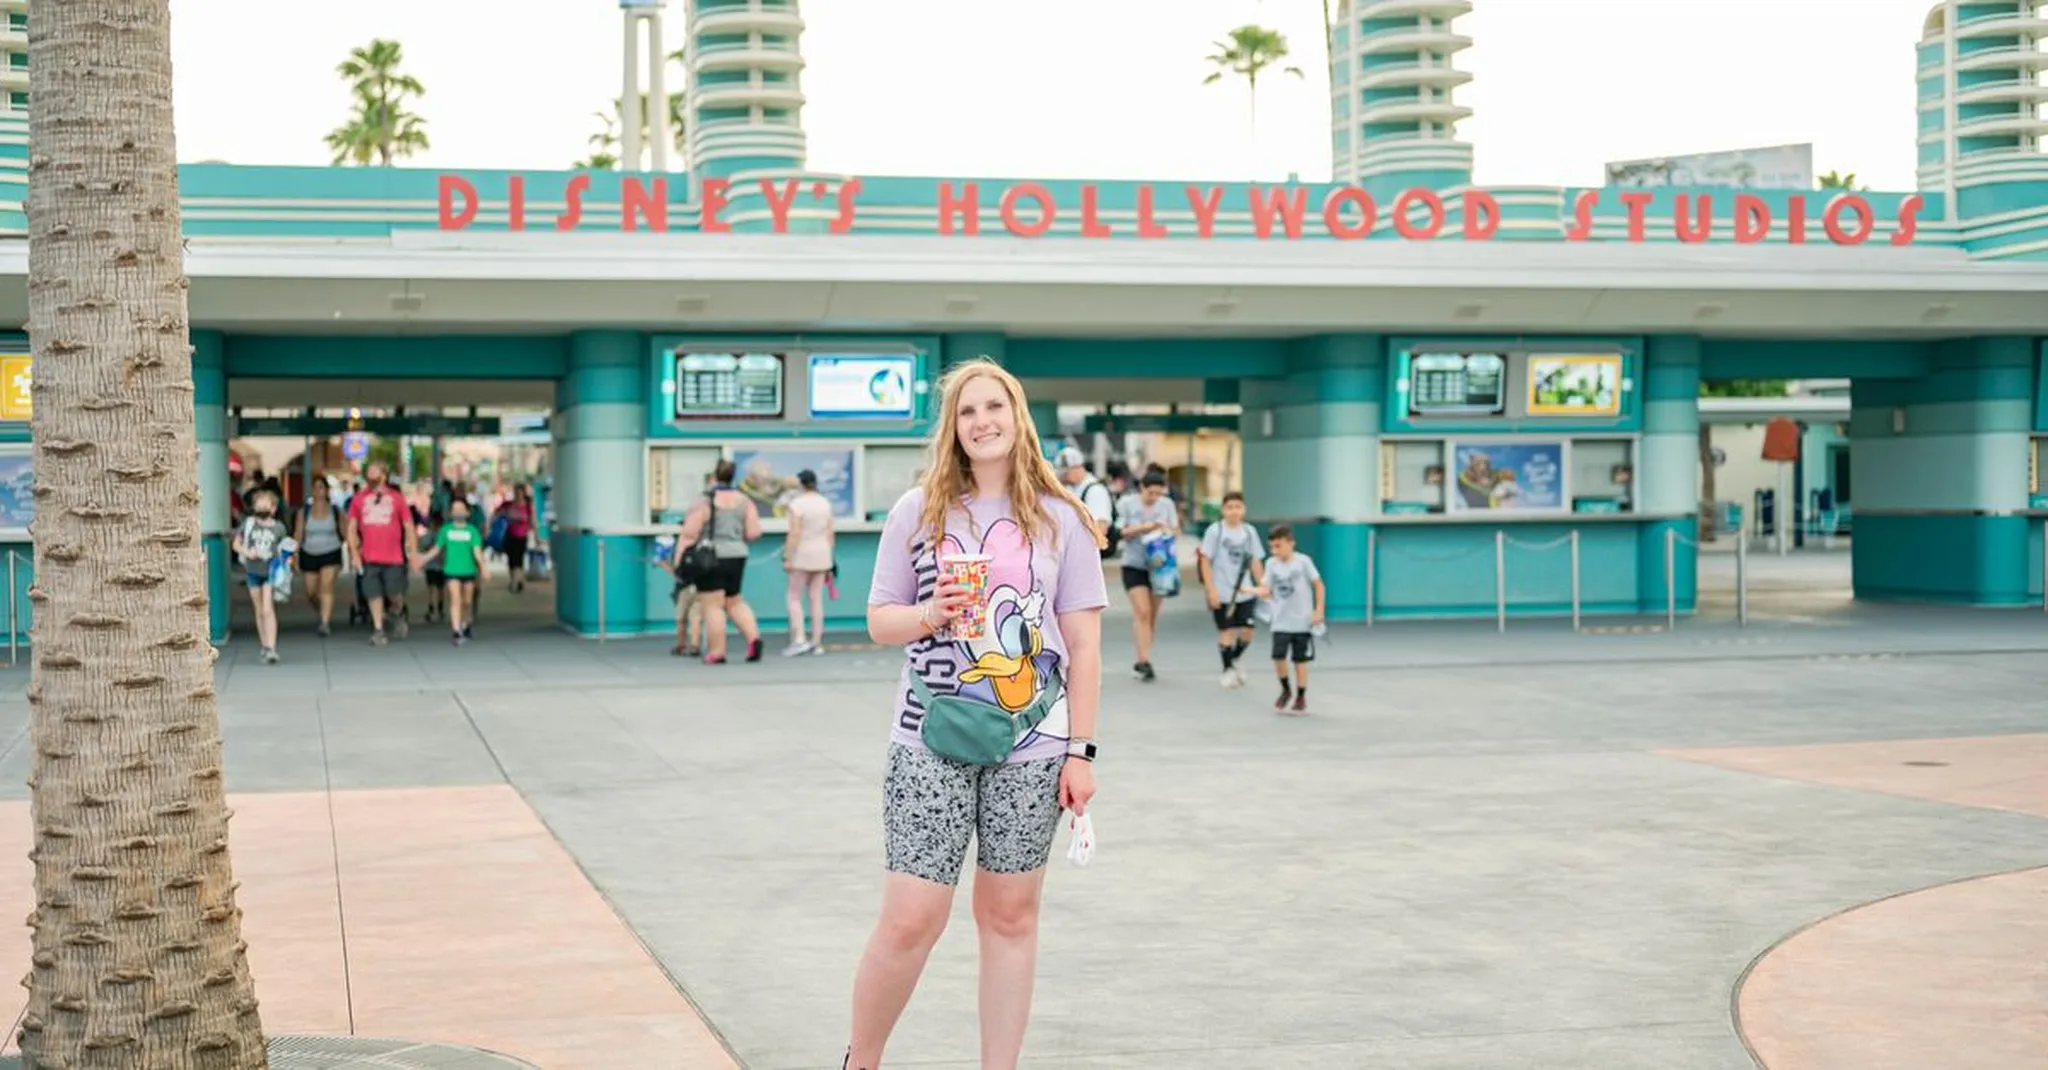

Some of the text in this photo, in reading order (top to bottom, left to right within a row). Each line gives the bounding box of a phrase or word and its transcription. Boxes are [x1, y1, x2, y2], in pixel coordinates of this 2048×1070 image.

[438, 174, 1925, 247] DISNEY'S HOLLYWOOD STUDIOS
